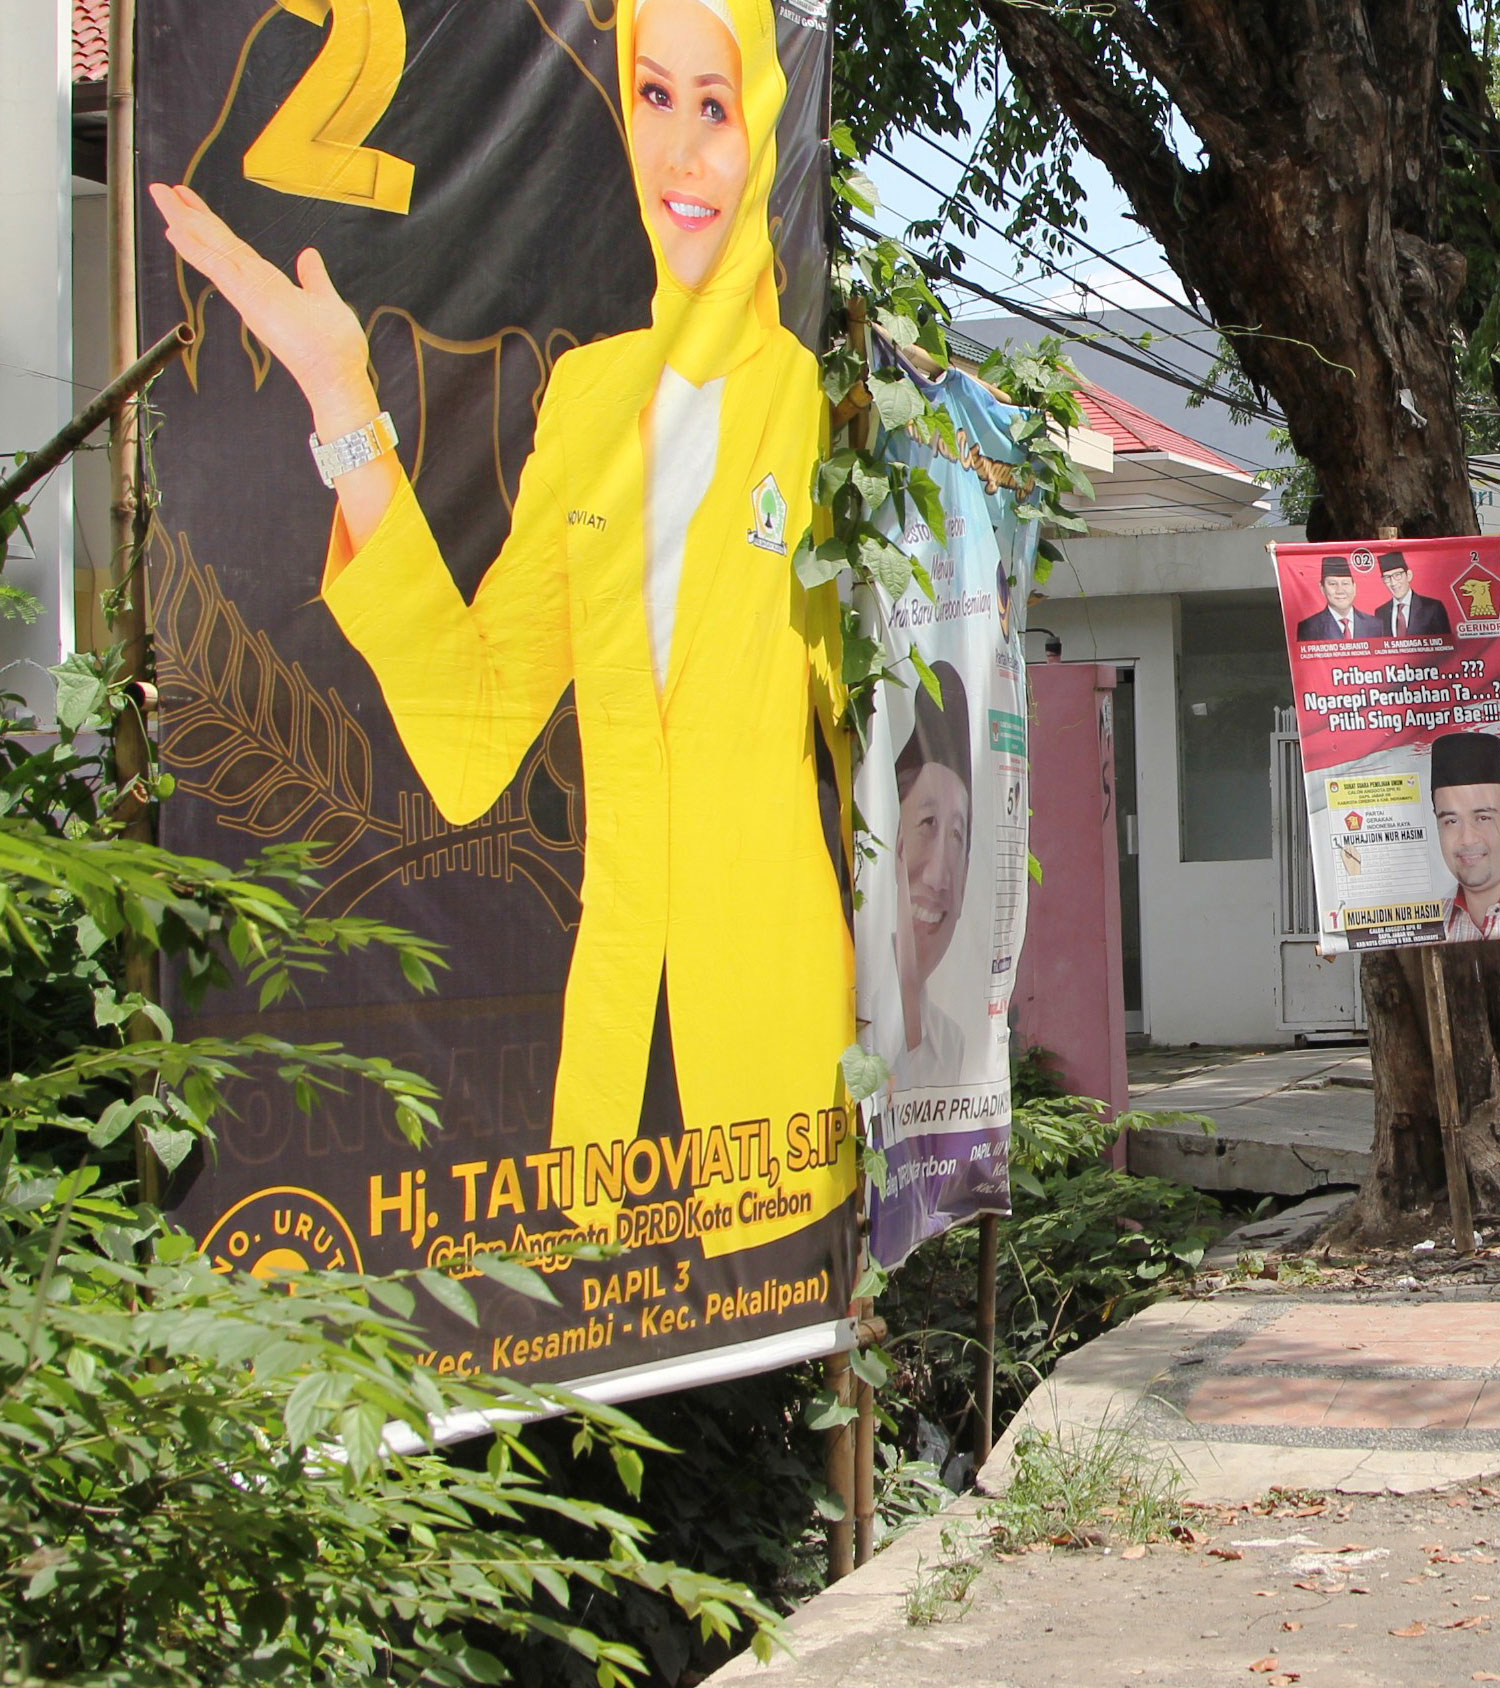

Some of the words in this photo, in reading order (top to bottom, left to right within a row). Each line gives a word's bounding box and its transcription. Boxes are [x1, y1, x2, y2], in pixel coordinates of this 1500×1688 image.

[243, 0, 415, 215] 2
[1354, 553, 1371, 567] 02
[1469, 551, 1480, 562] 2
[911, 598, 933, 626] Baru
[1339, 641, 1369, 651] SUBIANTO
[1391, 639, 1422, 648] SANDIAGA
[1332, 667, 1384, 686] Priben
[1304, 688, 1367, 715] Ngarepi
[1369, 684, 1450, 707] Perubahan
[1329, 710, 1366, 732] Pilih
[1367, 709, 1403, 733] Sing
[1405, 708, 1451, 731] Anyar
[1007, 787, 1014, 816] 5
[1343, 832, 1383, 845] MUHAJIDIN
[1384, 830, 1399, 841] NUR
[1401, 829, 1424, 840] HASIM
[1329, 911, 1339, 929] 1
[1347, 908, 1393, 926] MUHAJIDIN
[1395, 906, 1412, 921] NUR
[1414, 903, 1440, 919] HASIM
[969, 1141, 991, 1161] DAPIL
[369, 1167, 440, 1250] Hj.
[451, 1146, 574, 1223] TATI
[584, 1117, 780, 1207] NOVIATI,
[786, 1106, 849, 1172] S.IP
[615, 1199, 684, 1249] DPRD
[685, 1194, 733, 1240] Kota
[737, 1187, 813, 1227] Cirebon
[273, 1208, 347, 1271] URUT
[583, 1265, 667, 1312] DAPIL
[674, 1260, 691, 1293] 3
[492, 1313, 614, 1372] Kesambi
[641, 1303, 697, 1339] Kec.
[704, 1268, 830, 1326] Pekalipan)
